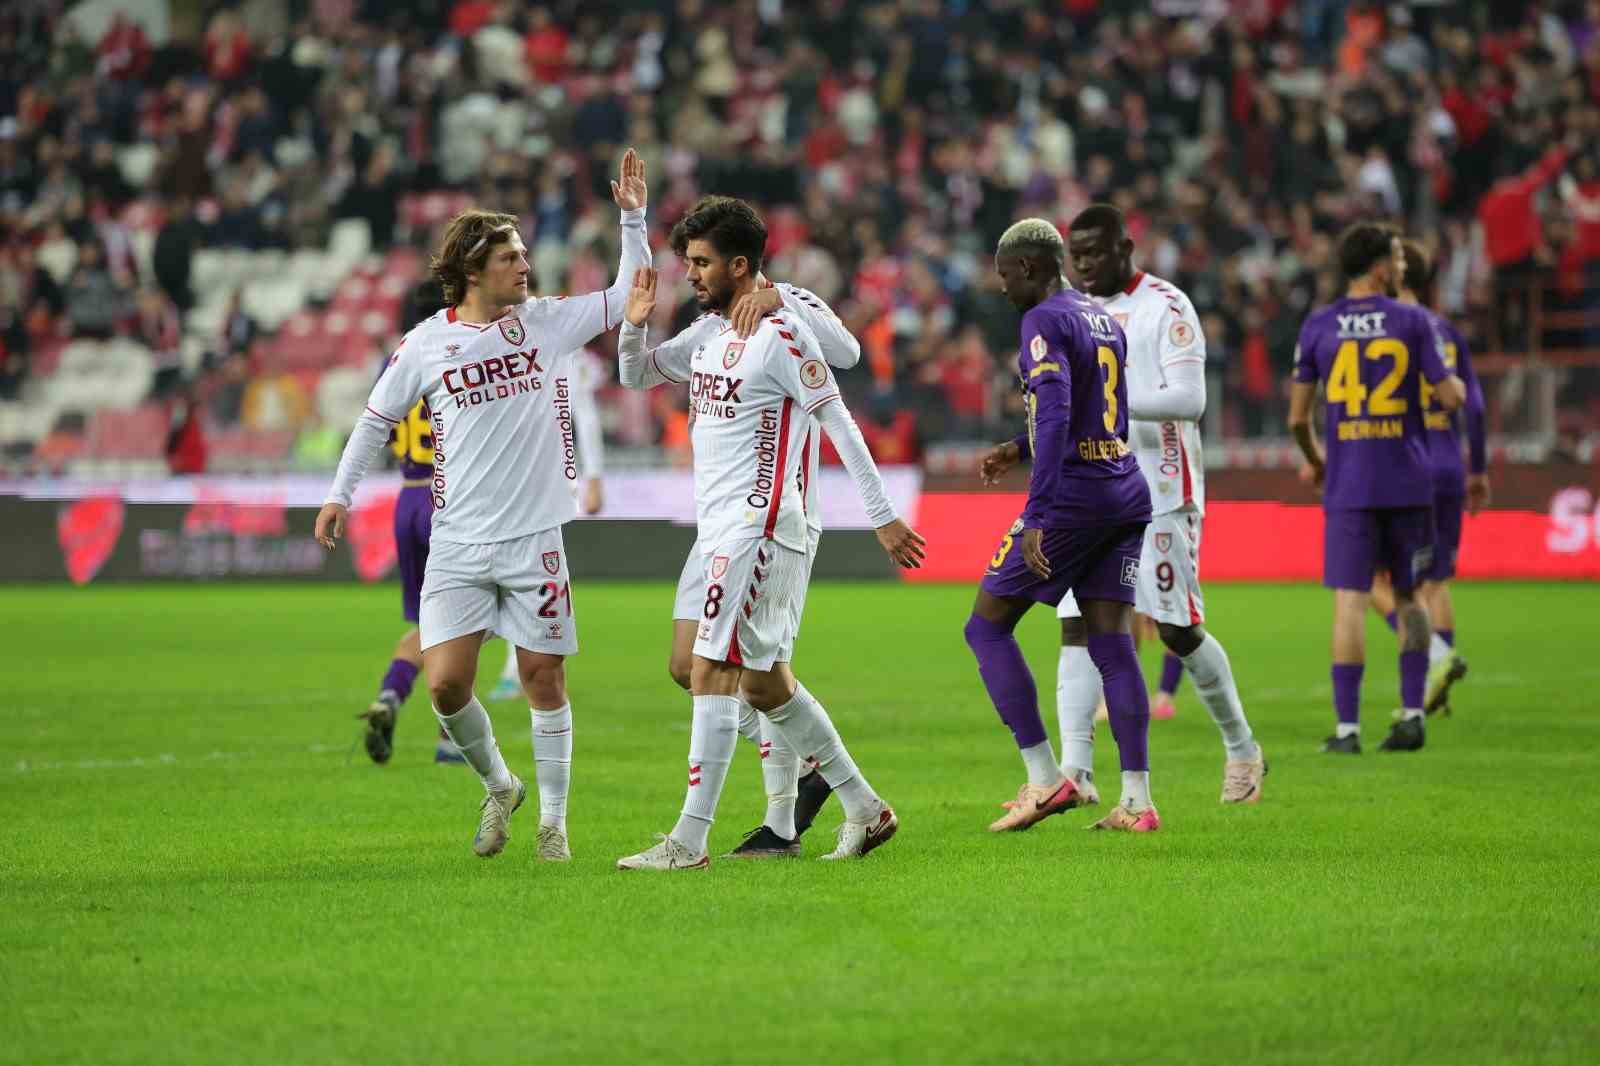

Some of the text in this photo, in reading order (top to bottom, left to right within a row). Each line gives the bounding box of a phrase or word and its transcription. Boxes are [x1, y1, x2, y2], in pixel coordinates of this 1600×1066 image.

[1337, 311, 1386, 332] YKT
[442, 348, 543, 395] COREX
[691, 371, 744, 404] OREX
[1097, 346, 1119, 433] 3
[1326, 338, 1408, 417] 42
[455, 377, 542, 409] HOLDING
[553, 376, 577, 480] Otomobilen
[746, 408, 777, 509] Otomobilen
[1160, 421, 1179, 478] Otomo
[991, 535, 1013, 568] 3
[1156, 562, 1175, 592] 9
[538, 580, 571, 618] 21
[704, 583, 723, 619] 8
